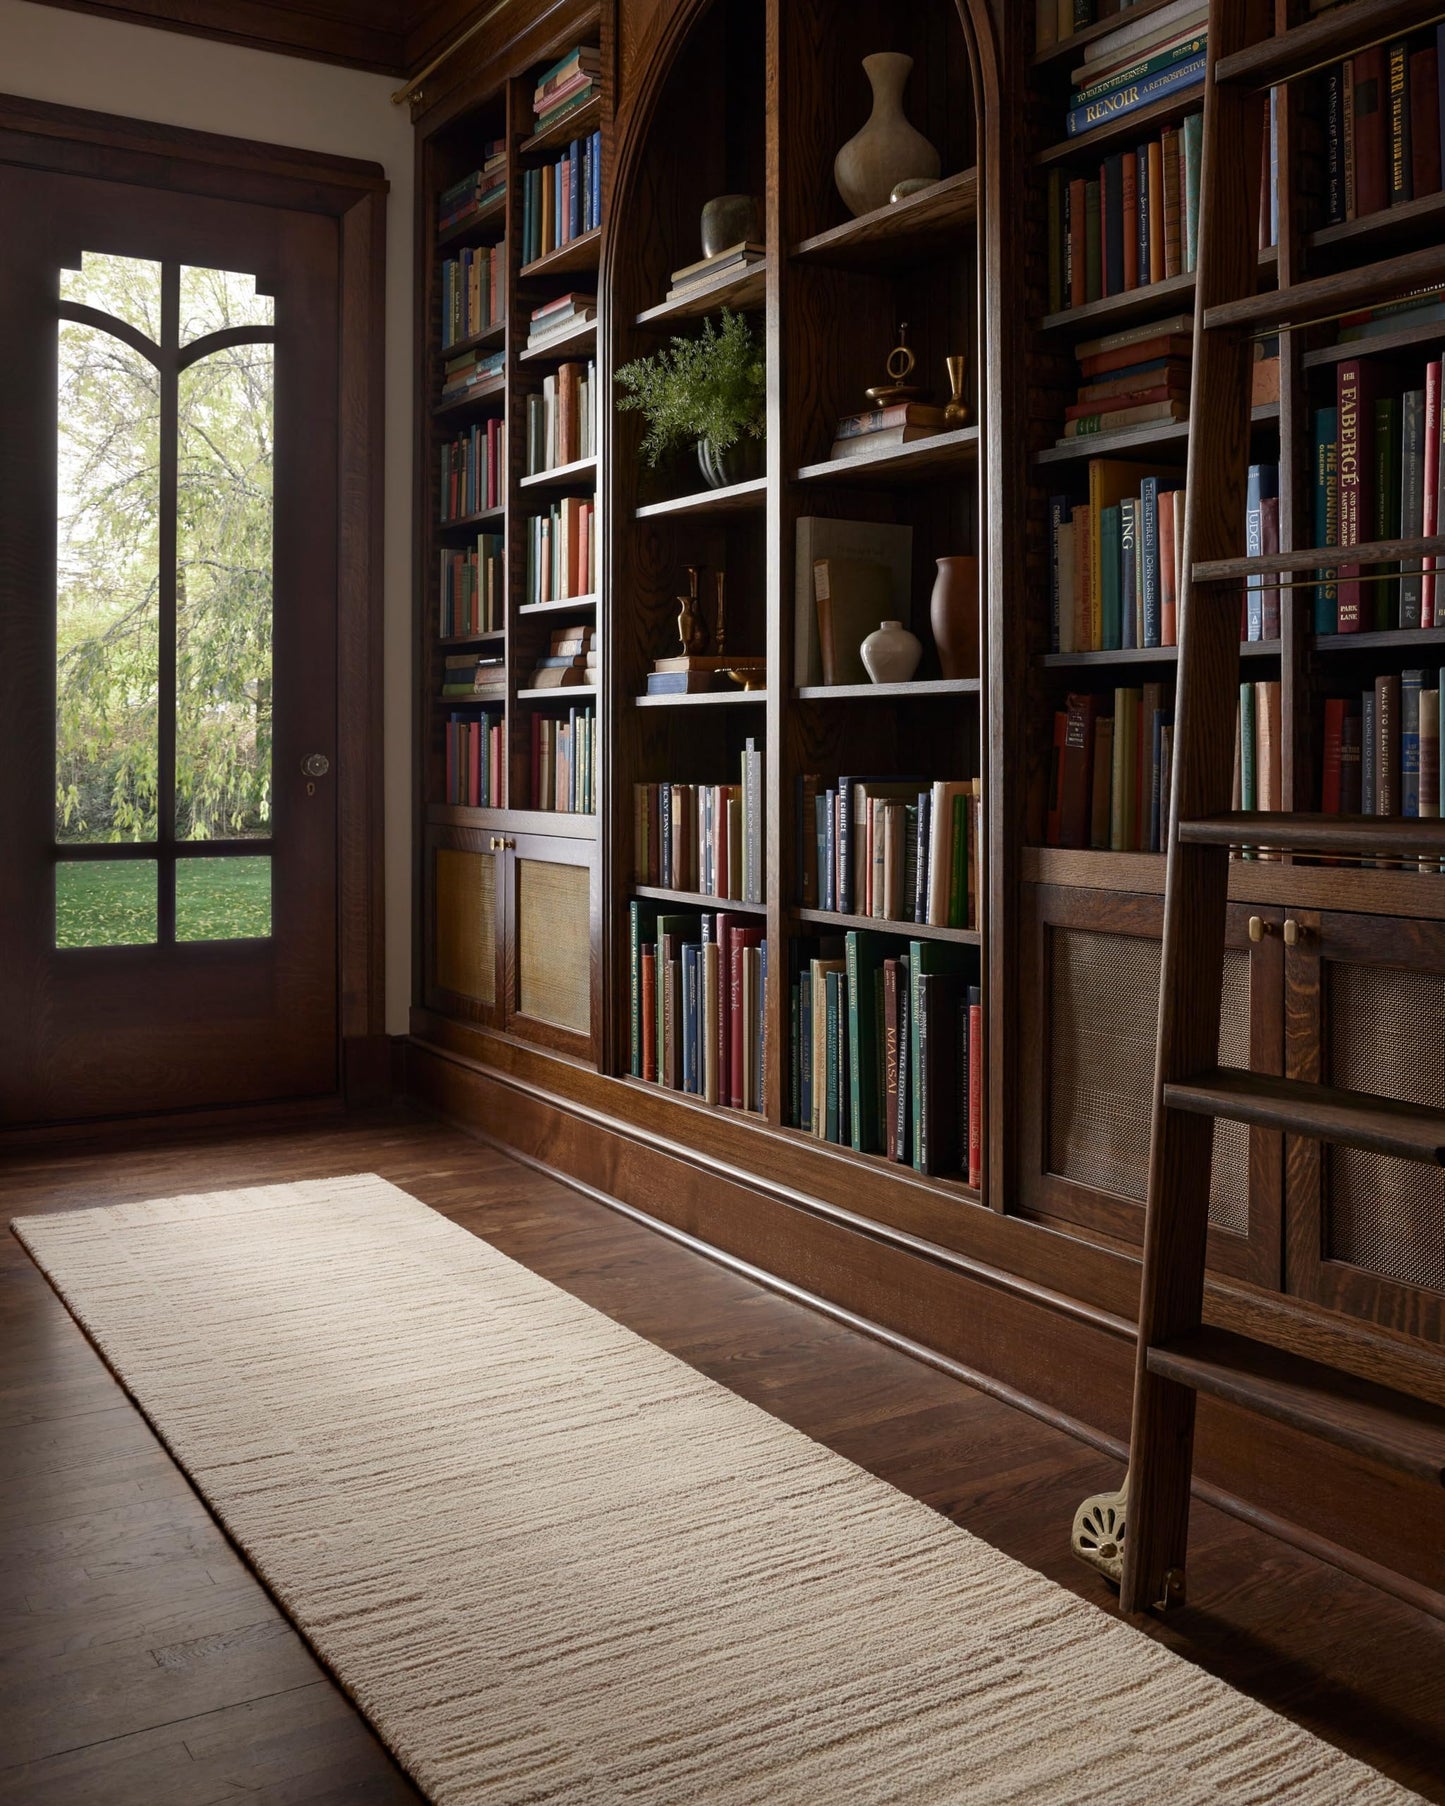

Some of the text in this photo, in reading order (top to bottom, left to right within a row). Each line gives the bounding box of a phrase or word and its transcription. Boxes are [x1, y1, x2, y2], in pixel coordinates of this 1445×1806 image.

[1110, 63, 1149, 90] WILDERNESS
[1142, 58, 1207, 99] A RETROSPECTIVE
[1390, 54, 1405, 94] KERR
[1085, 85, 1141, 123] RENOIR
[1392, 98, 1403, 191] THE LADY FROM ZAGREB
[1341, 386, 1360, 488] FABERGÉ
[1327, 442, 1338, 473] THE
[1145, 483, 1153, 502] THE
[1326, 474, 1338, 545] RUNNING
[1121, 503, 1134, 550] LING
[1248, 510, 1261, 552] JUDGE
[1146, 555, 1154, 623] JOHN GRISHAM
[1340, 604, 1358, 612] PARK
[1340, 613, 1358, 621] LANE
[1366, 700, 1374, 714] THE
[1381, 686, 1390, 711] WALK
[1381, 713, 1390, 726] TO
[747, 744, 754, 759] NO
[1366, 746, 1373, 757] TO
[1381, 728, 1390, 779] BEAUTIFUL
[632, 966, 638, 975] of
[730, 946, 741, 1011] New York
[887, 1027, 897, 1095] MAASAI
[971, 1105, 981, 1150] BUILDERS
